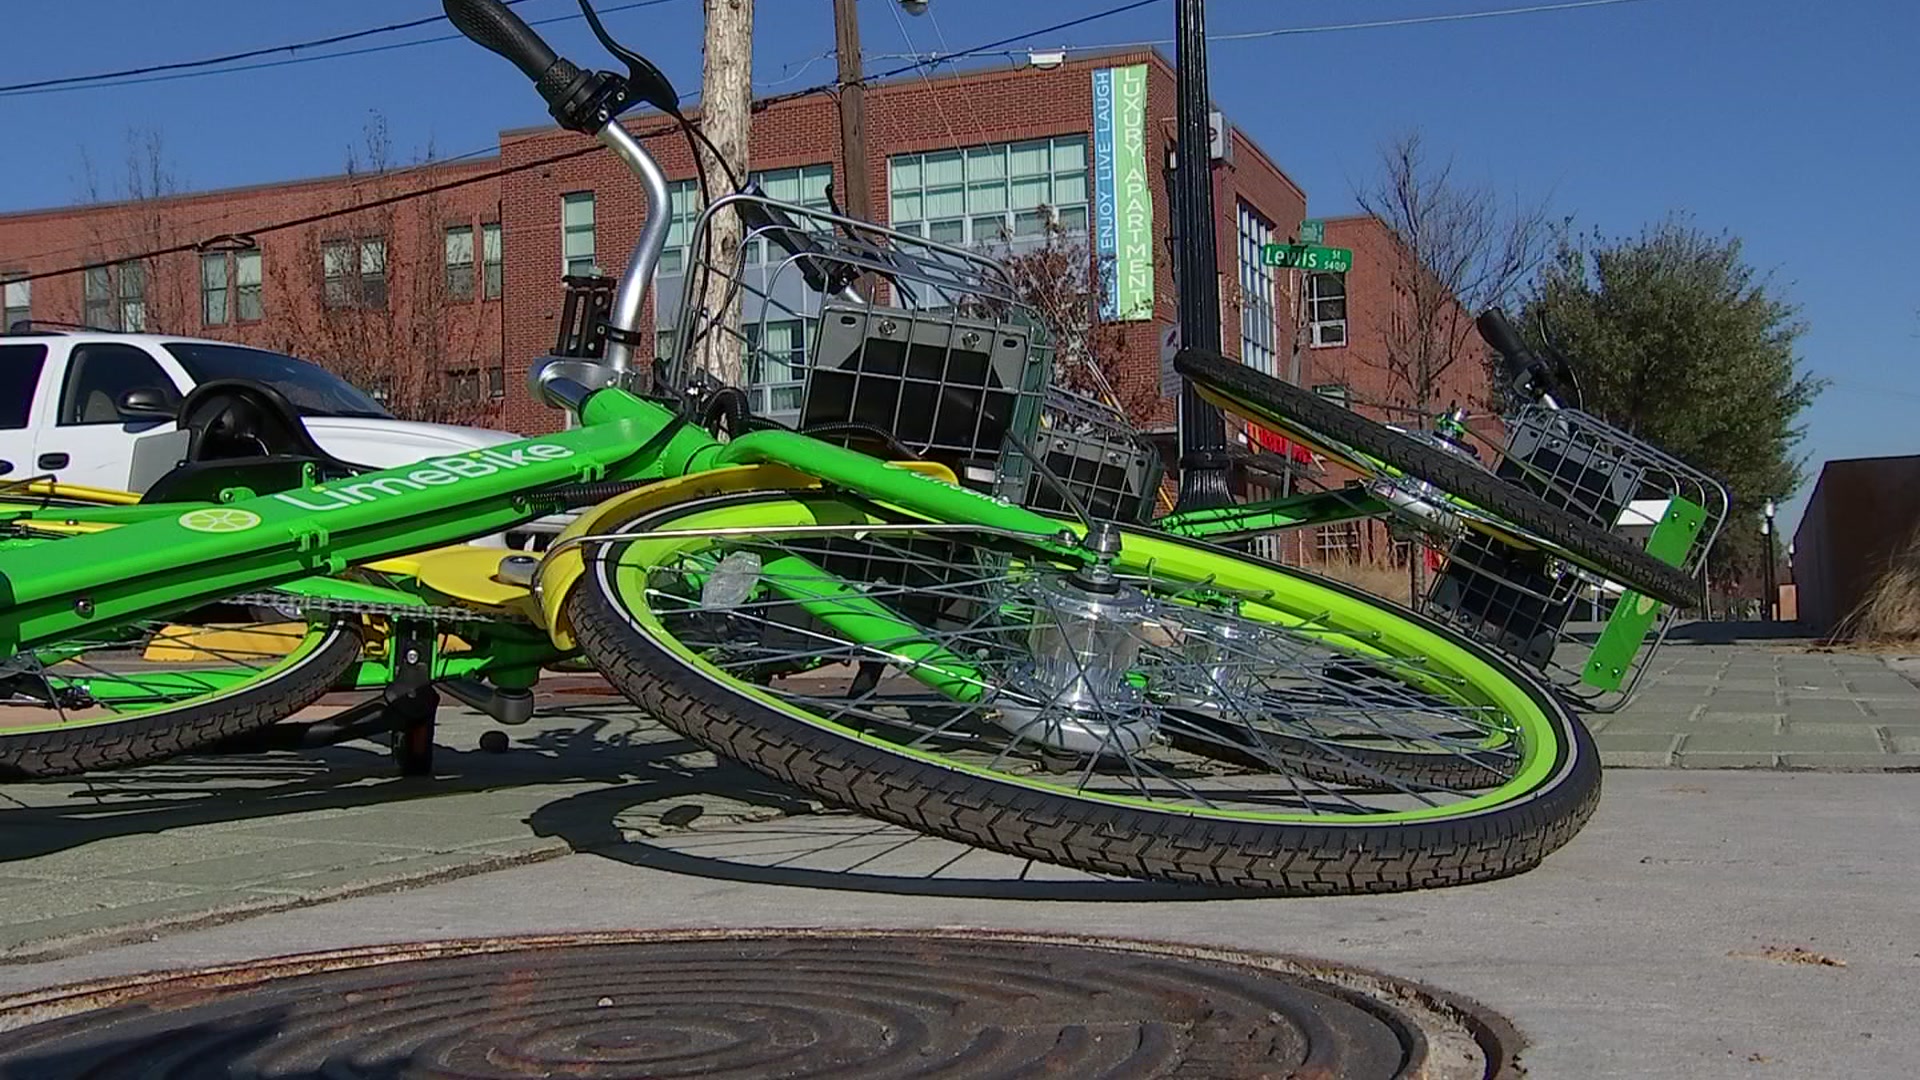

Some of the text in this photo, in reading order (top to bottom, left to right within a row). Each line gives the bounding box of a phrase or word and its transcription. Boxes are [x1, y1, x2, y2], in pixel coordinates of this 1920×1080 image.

[1096, 72, 1110, 132] LAUGH
[1123, 67, 1142, 157] LUXURY
[1098, 141, 1111, 180] LIVE
[1100, 192, 1114, 249] ENJOY
[1266, 247, 1317, 267] Lewis
[1324, 261, 1346, 272] 5400
[273, 444, 575, 510] LimeBike
